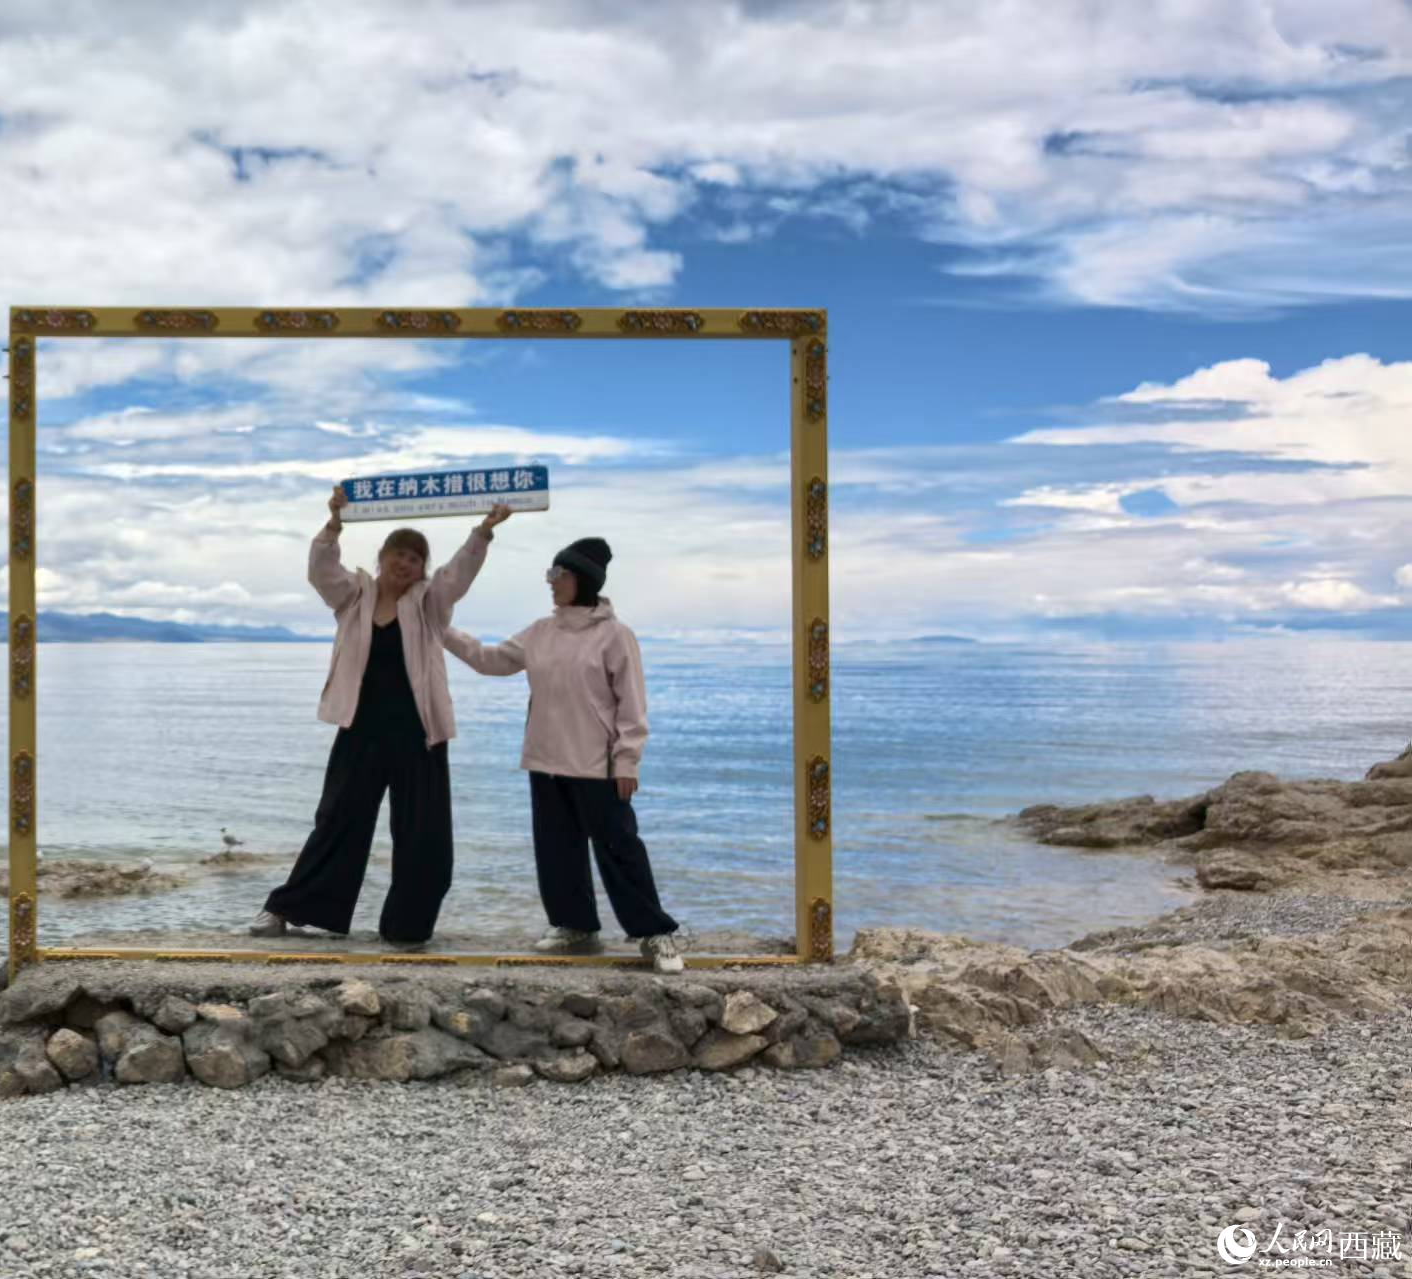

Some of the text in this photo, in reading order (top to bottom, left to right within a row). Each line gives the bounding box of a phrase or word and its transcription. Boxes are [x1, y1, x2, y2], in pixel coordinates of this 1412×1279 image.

[353, 469, 536, 499] 我在纳木措很想你
